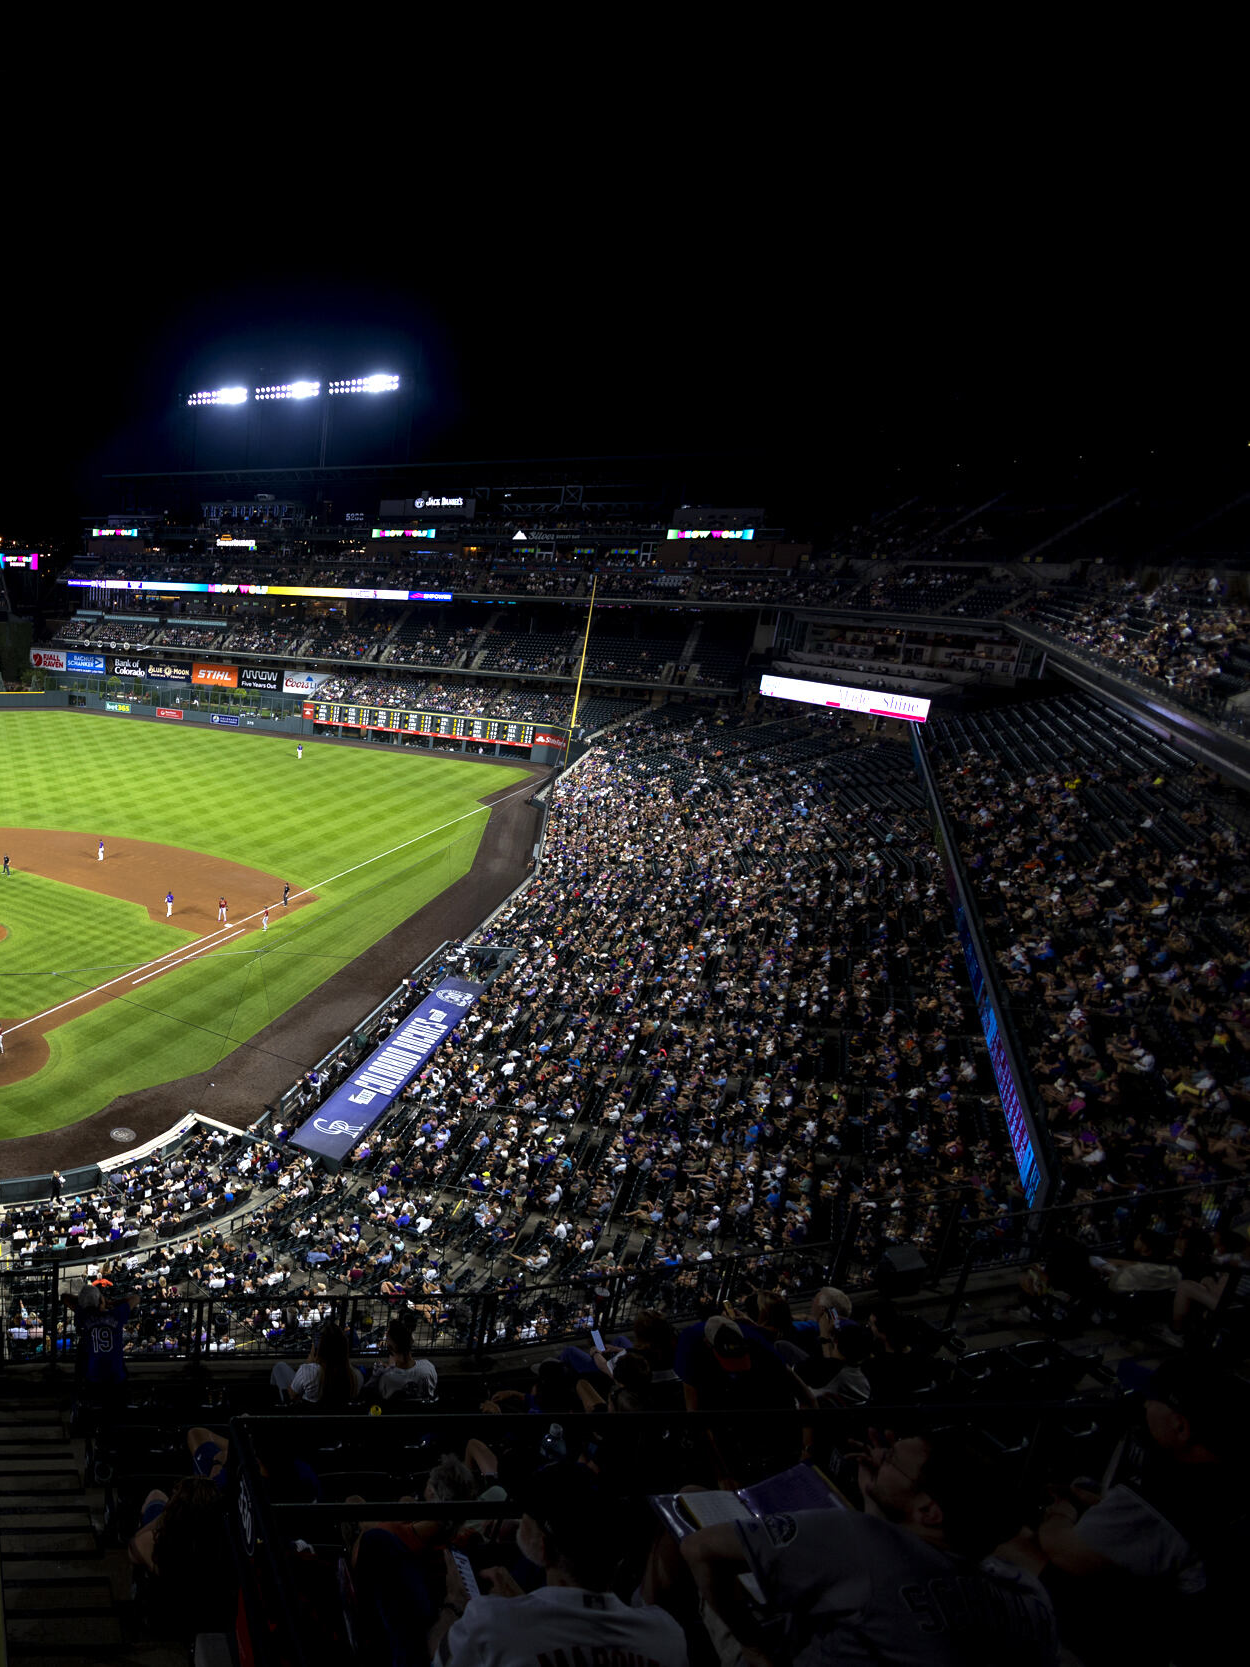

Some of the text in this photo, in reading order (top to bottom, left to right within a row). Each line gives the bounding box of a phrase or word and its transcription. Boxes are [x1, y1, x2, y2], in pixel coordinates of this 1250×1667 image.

[678, 530, 743, 539] MEOW WOLF
[208, 584, 268, 594] MEOW WOLF
[115, 659, 132, 667] Bank
[115, 667, 145, 677] Colorado
[148, 665, 162, 674] BLUE
[198, 669, 231, 681] STIHL
[242, 669, 278, 681] ARROW
[285, 677, 309, 688] Coors
[106, 703, 129, 712] bet365
[354, 1017, 448, 1095] COLORADO ROCKIES
[91, 1327, 113, 1353] 19
